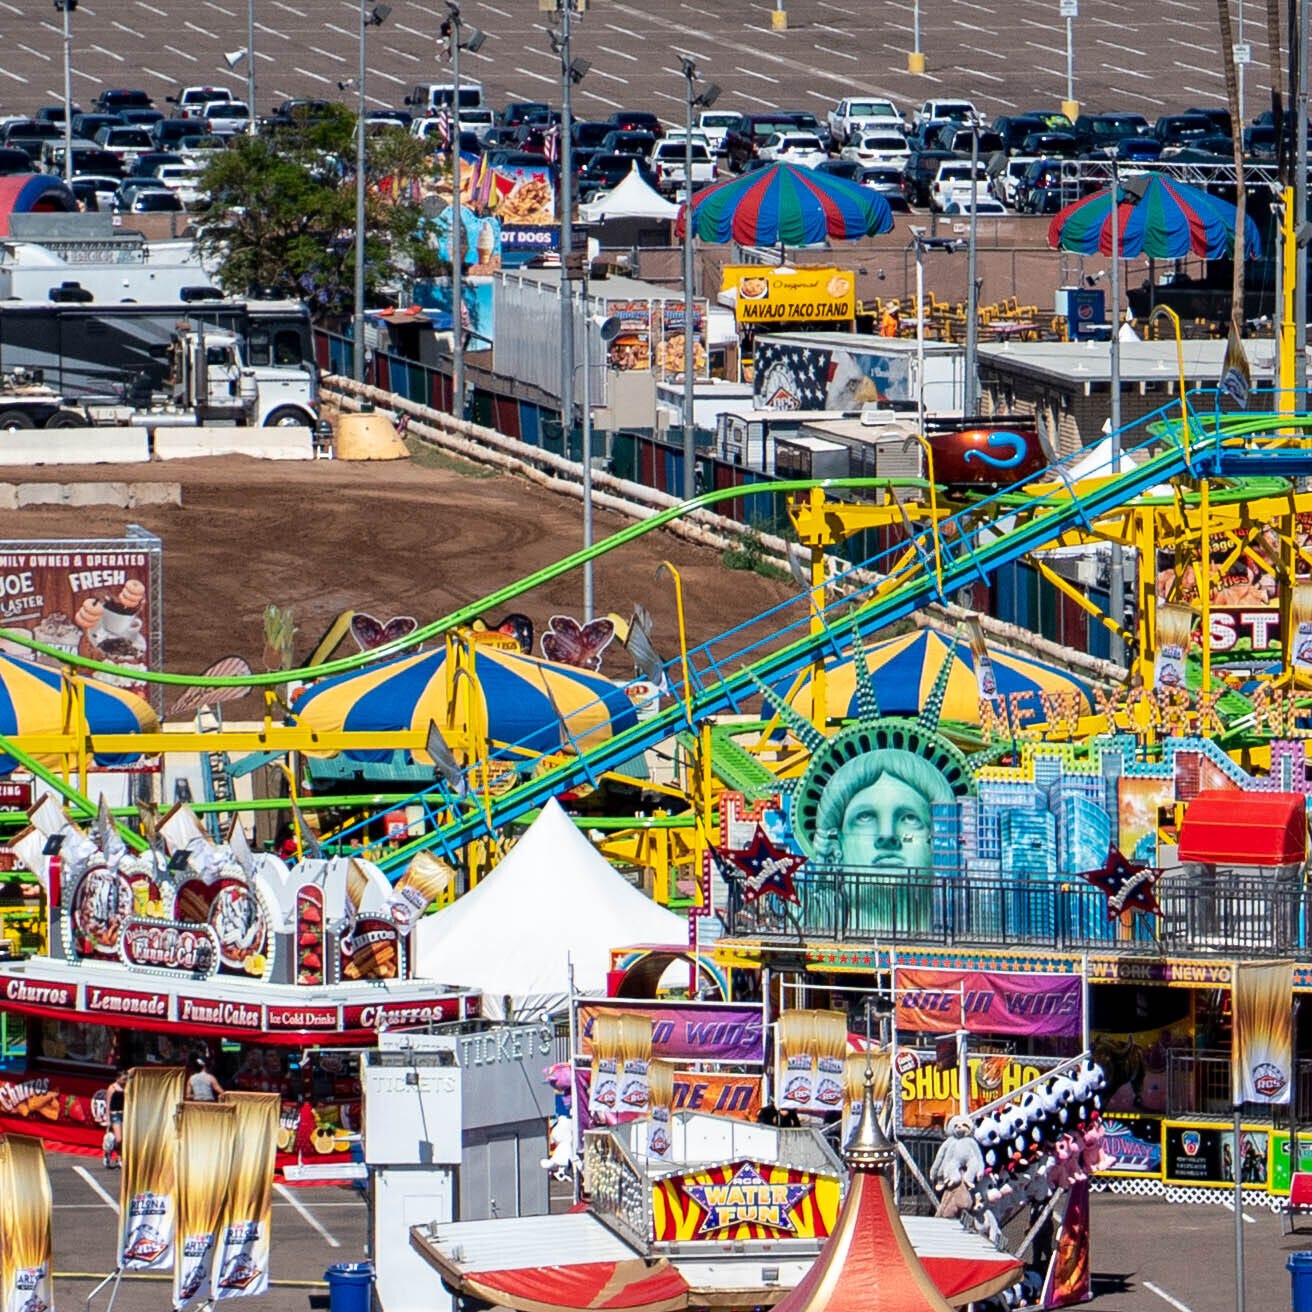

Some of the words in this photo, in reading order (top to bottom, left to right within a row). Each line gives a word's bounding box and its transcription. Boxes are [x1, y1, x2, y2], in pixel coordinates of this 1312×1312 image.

[500, 233, 516, 244] OT
[518, 233, 552, 244] DOGS
[743, 304, 785, 318] NAVAJO
[788, 304, 814, 317] TACO
[815, 303, 848, 317] STAND
[29, 555, 70, 567] OWNED
[73, 555, 82, 567] &
[86, 554, 145, 567] OPERATED
[0, 572, 34, 597] JOE
[69, 569, 126, 593] FRESH
[978, 689, 1083, 742] NEW
[1093, 685, 1227, 739] YORK
[134, 942, 174, 963] Funnel
[1073, 963, 1104, 976] NEW
[1171, 965, 1205, 980] NEW
[6, 981, 68, 1005] Churros
[89, 990, 166, 1016] Lemonade
[901, 988, 952, 1010] ONE
[961, 989, 991, 1013] IN
[1003, 990, 1079, 1014] WINS
[183, 1001, 224, 1021] Funnel
[225, 1006, 260, 1026] Cakes
[269, 1013, 280, 1025] Ice
[282, 1012, 302, 1025] Cold
[305, 1012, 336, 1026] Drinks
[360, 1004, 444, 1028] Churros
[684, 1019, 762, 1047] WINS
[460, 1024, 553, 1066] TICKETS
[672, 1080, 704, 1103] NE
[716, 1080, 752, 1112] IN
[1098, 1139, 1153, 1158] ADWAY
[130, 1200, 166, 1210] RIZONA
[704, 1185, 788, 1206] WATER
[714, 1206, 779, 1226] FUN
